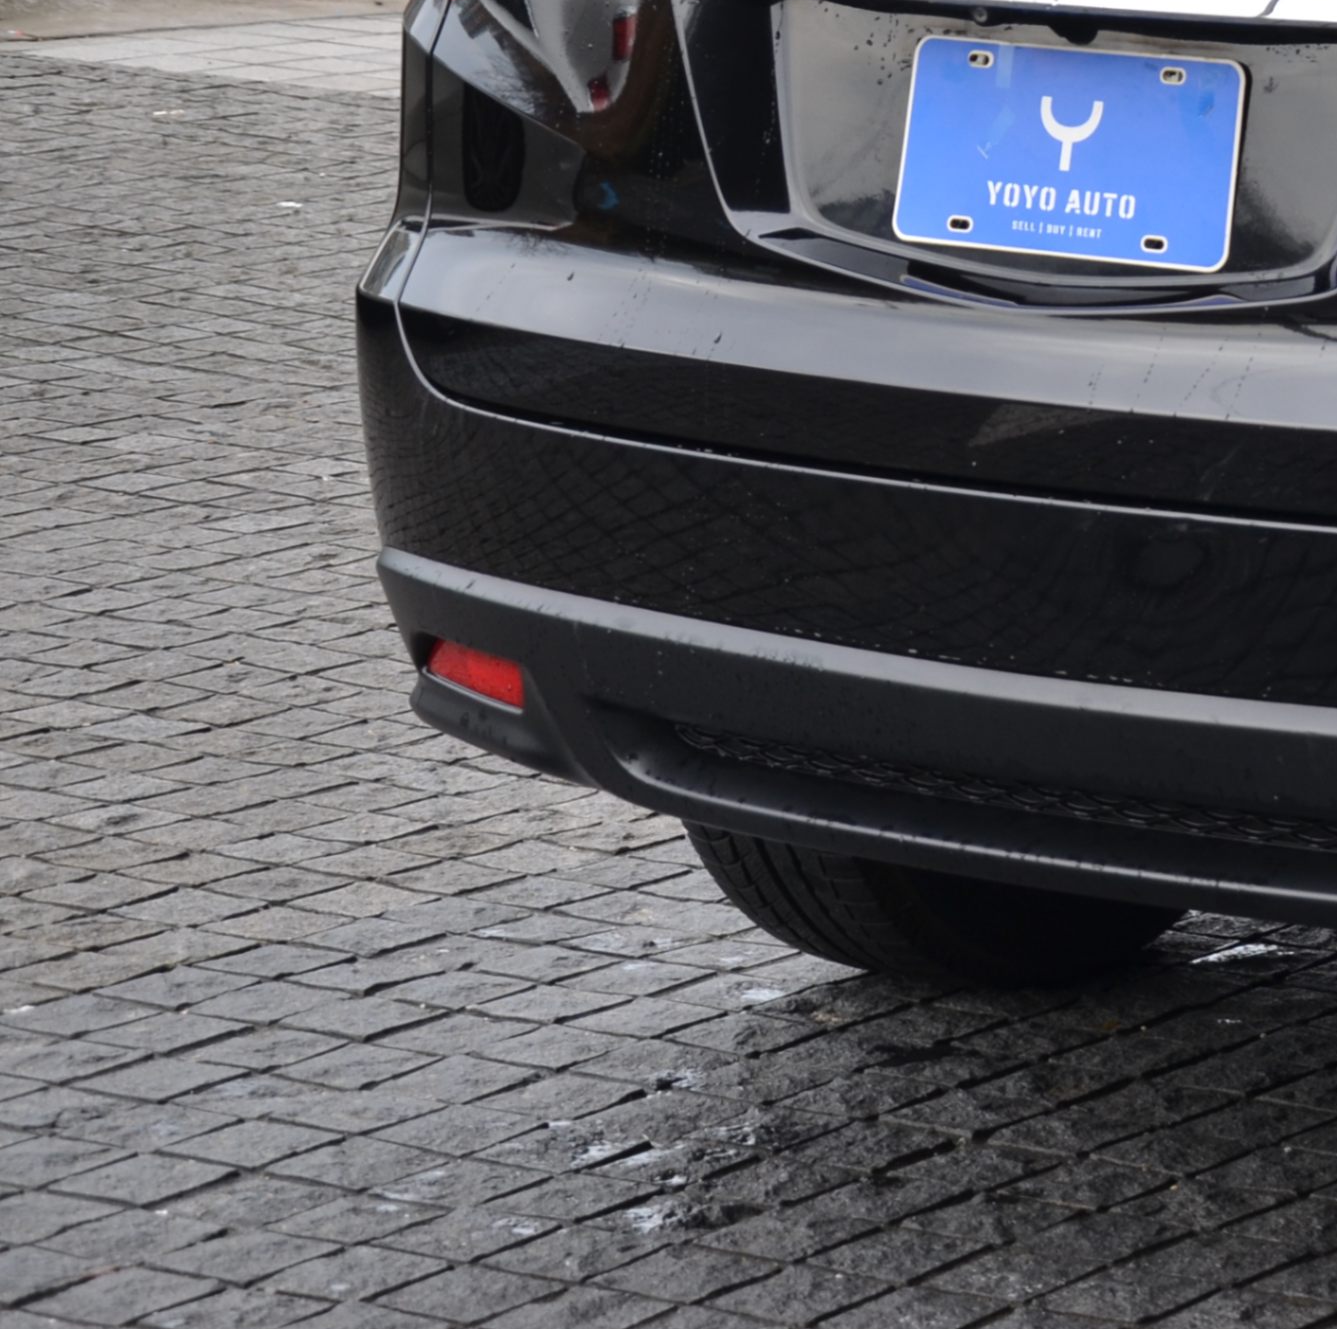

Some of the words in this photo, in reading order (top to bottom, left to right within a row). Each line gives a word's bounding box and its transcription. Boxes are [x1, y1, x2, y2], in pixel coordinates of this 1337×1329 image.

[986, 180, 1056, 212] YOYO
[1065, 189, 1136, 220] AUTO
[1012, 220, 1036, 233] SELL
[1046, 224, 1067, 236] BUY
